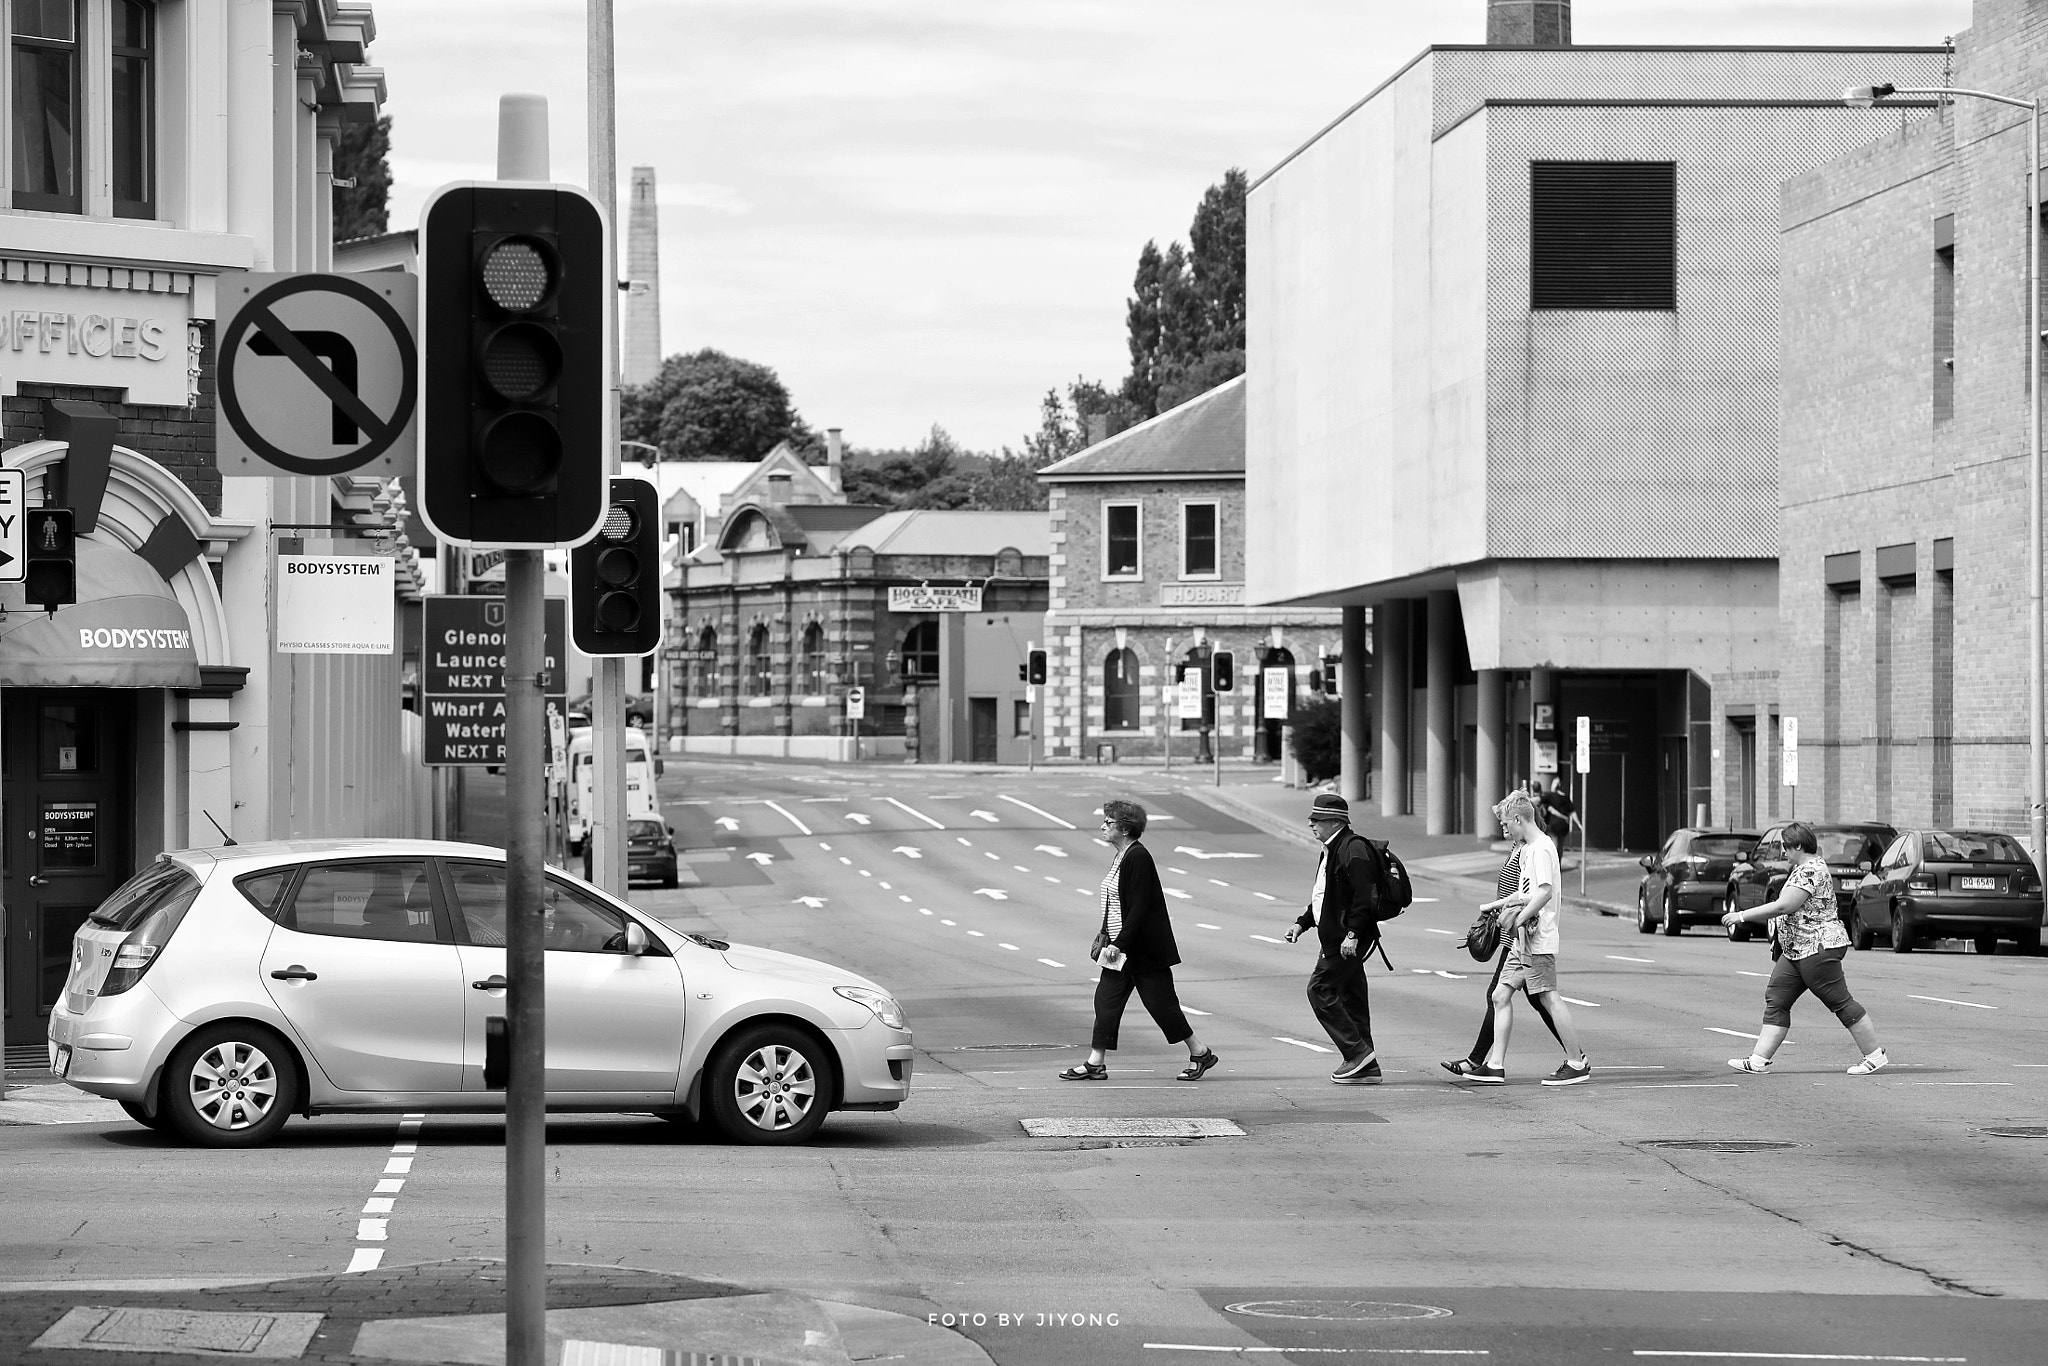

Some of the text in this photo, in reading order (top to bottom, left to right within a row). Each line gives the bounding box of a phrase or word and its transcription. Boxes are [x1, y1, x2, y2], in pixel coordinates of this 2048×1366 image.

[0, 309, 168, 361] FFICES
[1174, 587, 1240, 602] HOBART
[492, 606, 499, 621] 1
[279, 641, 302, 649] PHYSIO
[351, 642, 369, 650] AQUA
[436, 652, 555, 668] Launcen
[448, 675, 493, 688] NEXT
[431, 701, 485, 717] Wharf
[1536, 705, 1553, 722] P
[445, 745, 489, 758] NEXT
